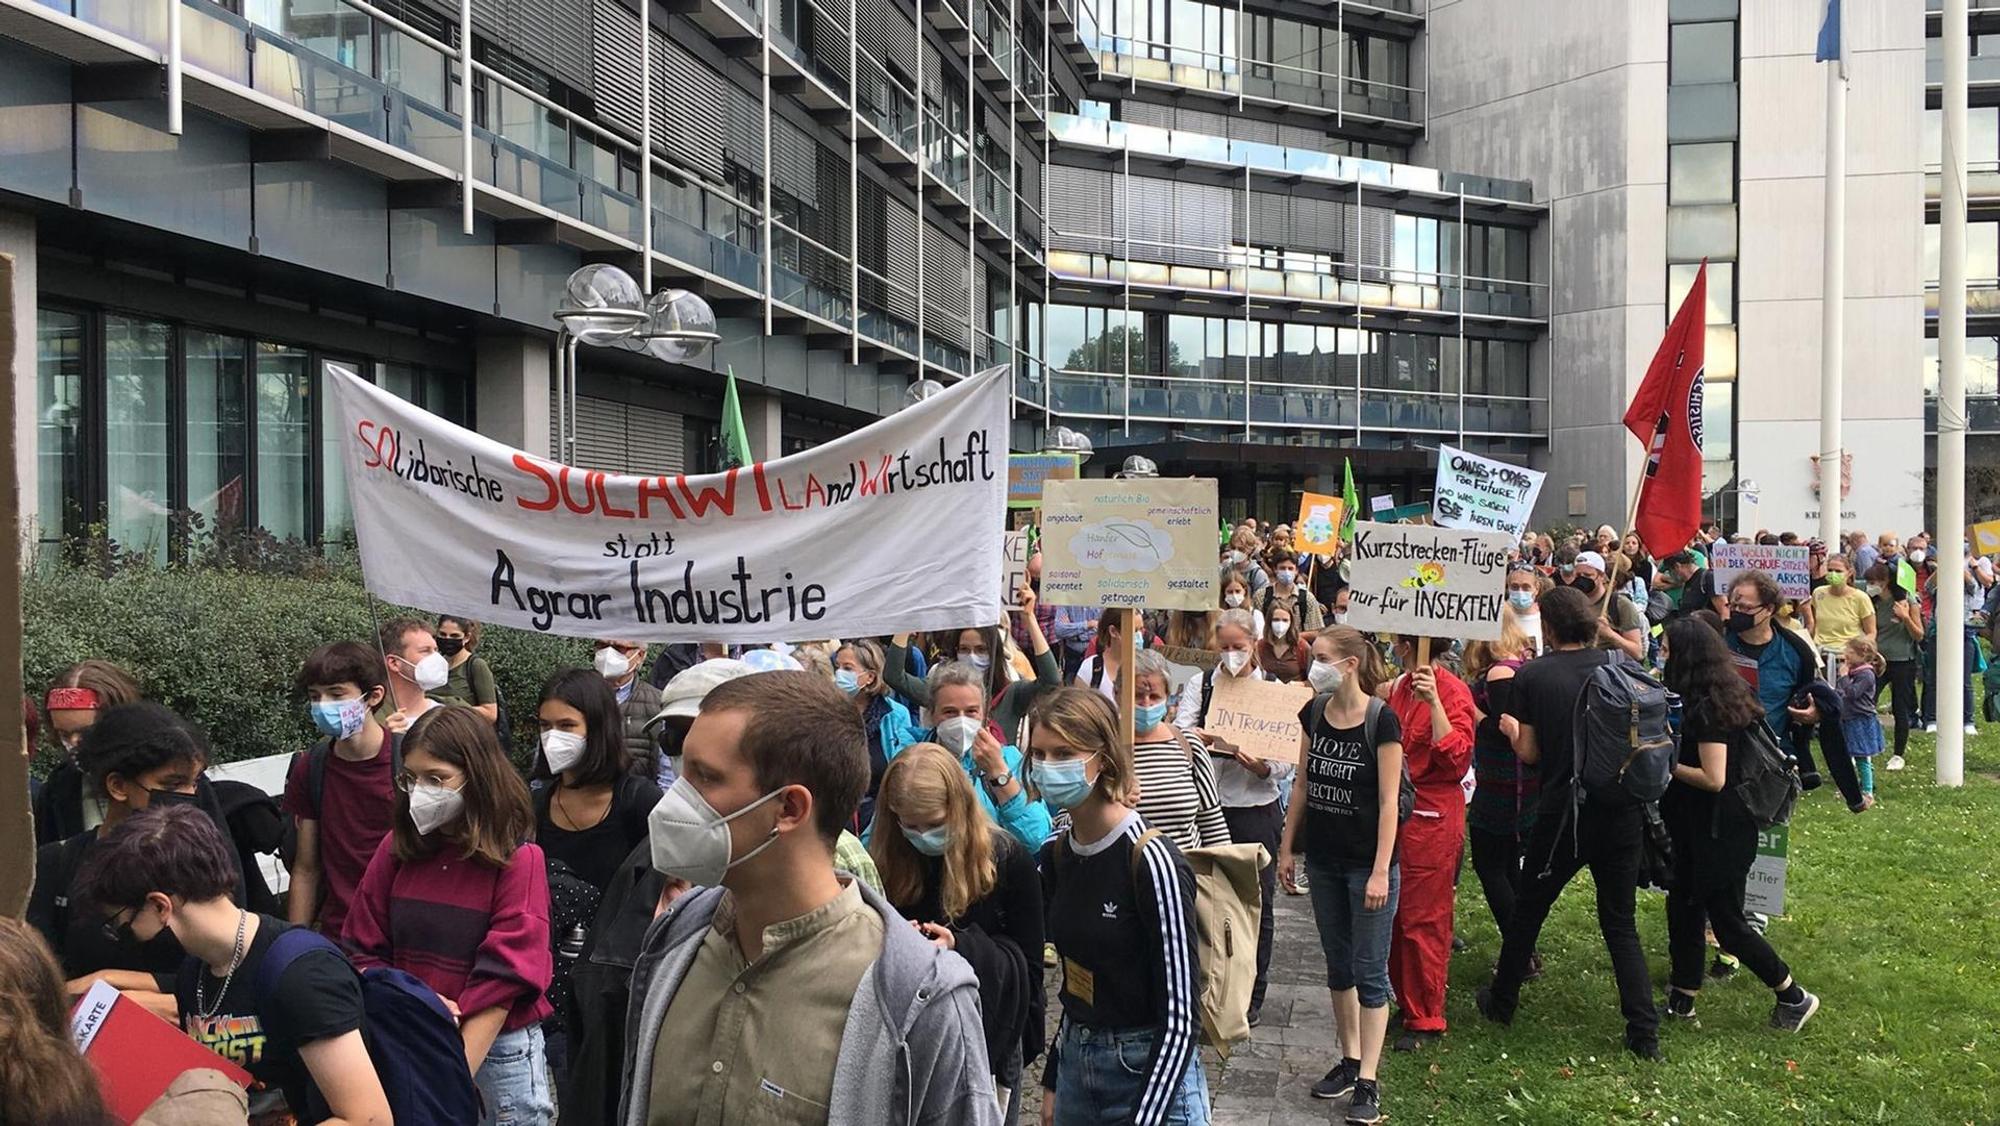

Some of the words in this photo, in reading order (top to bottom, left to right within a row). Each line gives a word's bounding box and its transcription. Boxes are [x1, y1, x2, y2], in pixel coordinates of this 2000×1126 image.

[1046, 514, 1083, 525] angebaut
[1167, 517, 1191, 525] erlebt
[602, 530, 676, 560] statt
[1354, 530, 1505, 575] Kurzstrecken-Flüge
[1714, 547, 1737, 557] WIR
[1775, 548, 1808, 559] NICHT
[1714, 559, 1727, 569] IN
[1728, 559, 1745, 569] DER
[1747, 559, 1781, 570] SCHULE
[1782, 561, 1809, 571] SITZEN
[491, 549, 612, 631] Agrar
[630, 556, 826, 625] Industrie
[1167, 580, 1209, 589] gestaltet
[1101, 593, 1145, 605] getragen
[1349, 588, 1379, 607] nur
[1379, 586, 1409, 615] für
[1414, 590, 1503, 622] INSEKTEN
[1215, 708, 1300, 736] INTROVERTS
[1319, 760, 1357, 780] RIGHT
[1757, 871, 1779, 884] Tier
